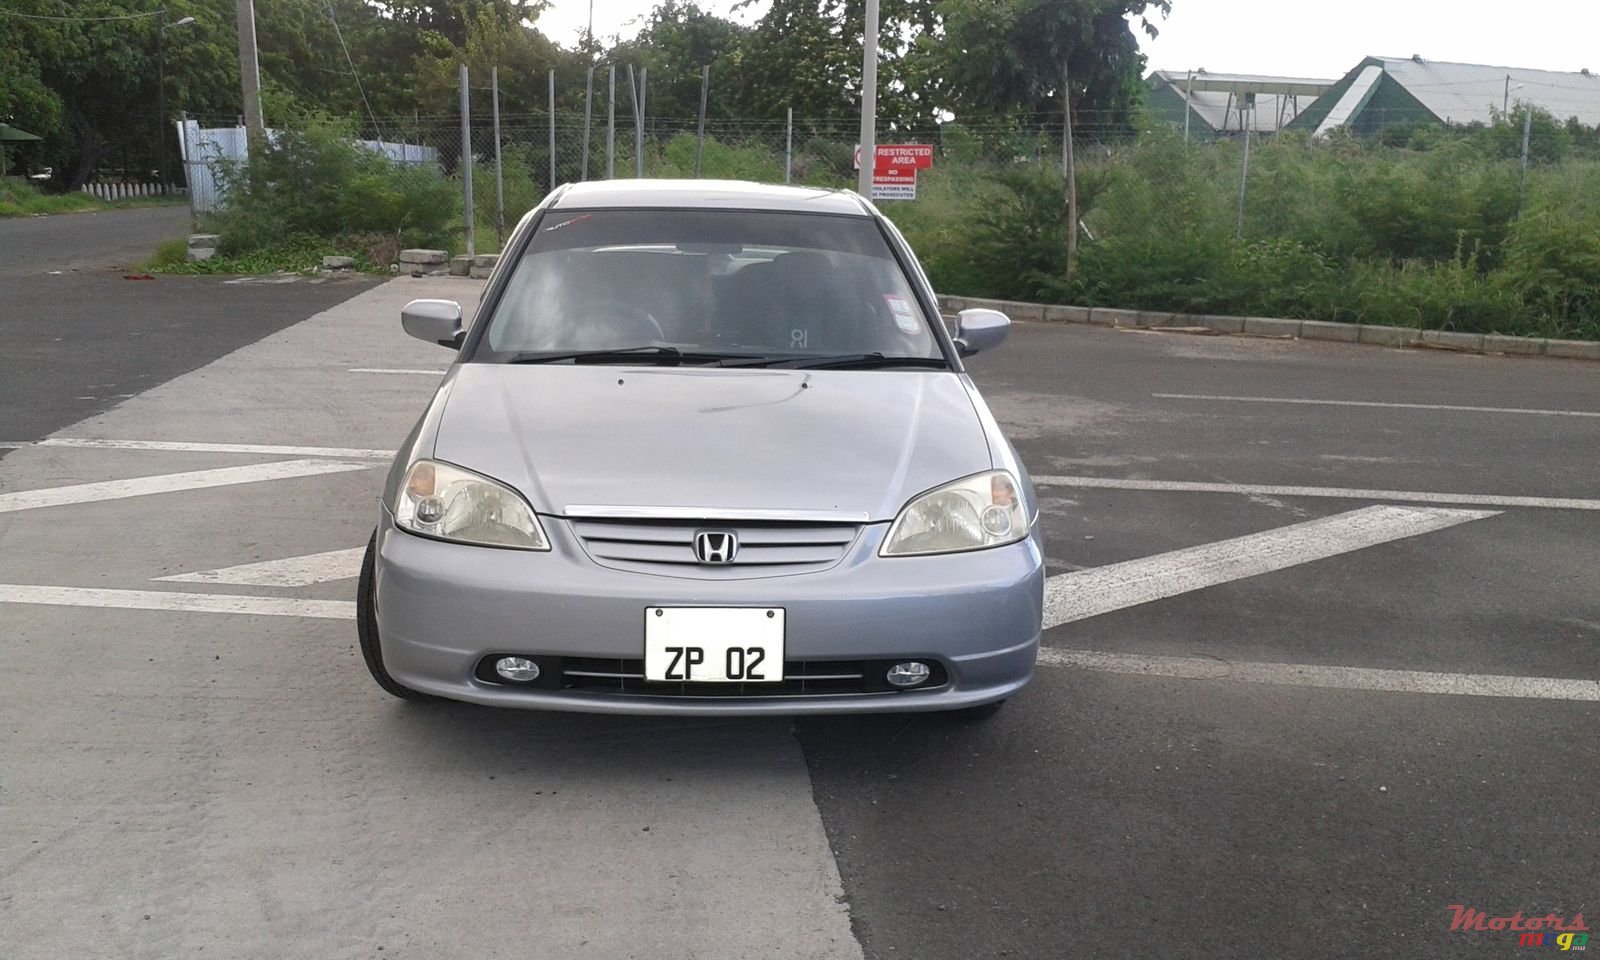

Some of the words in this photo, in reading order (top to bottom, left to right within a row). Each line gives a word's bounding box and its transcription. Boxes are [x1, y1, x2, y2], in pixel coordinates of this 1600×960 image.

[878, 148, 931, 156] RESTRICTED
[665, 647, 704, 680] ZP
[726, 647, 765, 680] 02
